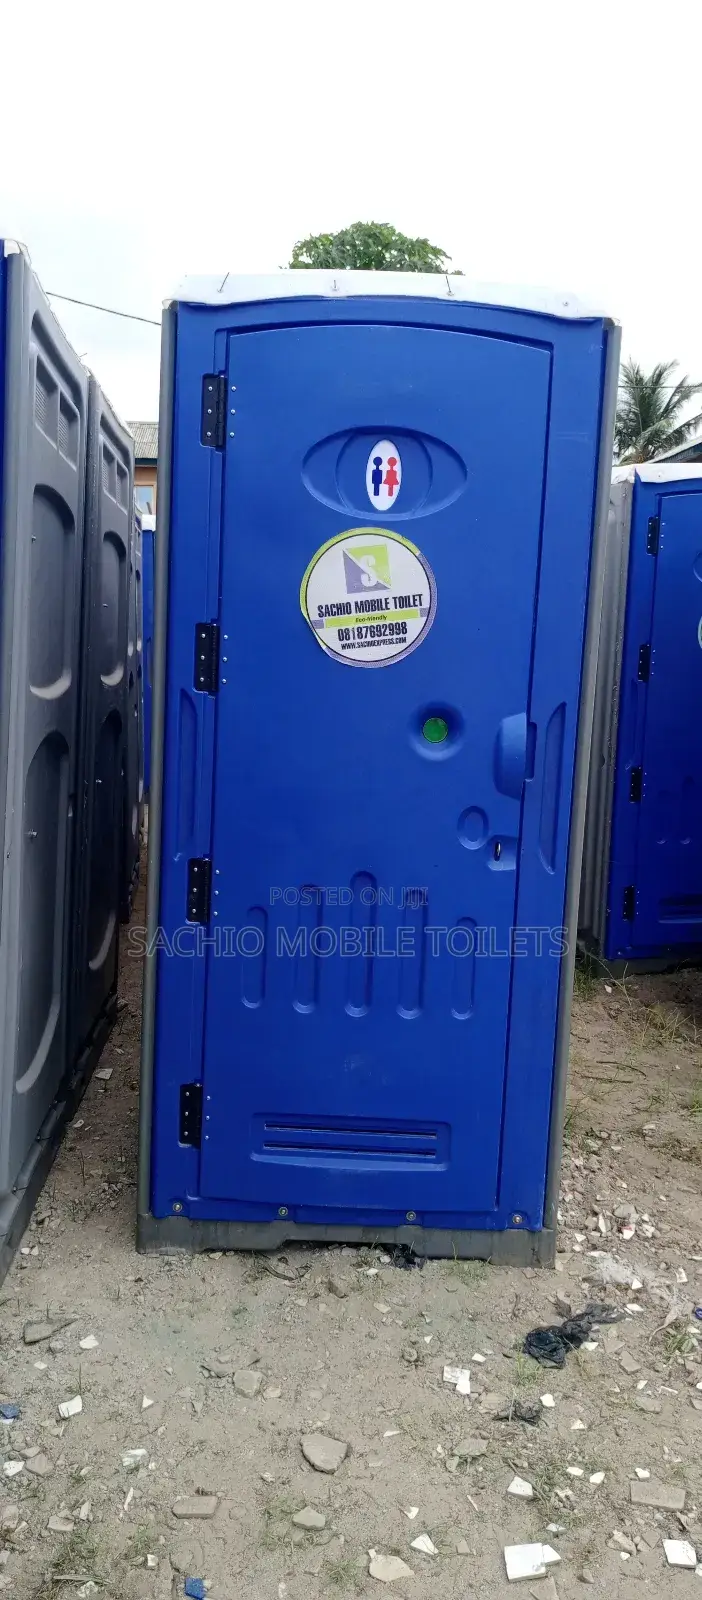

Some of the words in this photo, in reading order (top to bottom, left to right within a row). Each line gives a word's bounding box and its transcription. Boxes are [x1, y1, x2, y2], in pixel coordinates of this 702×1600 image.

[360, 555, 377, 587] S
[317, 602, 352, 618] SACHIO
[355, 597, 390, 613] MOBILE
[392, 594, 423, 609] TOILET
[355, 614, 388, 623] Eco-friendly
[337, 622, 408, 641] 08187692998
